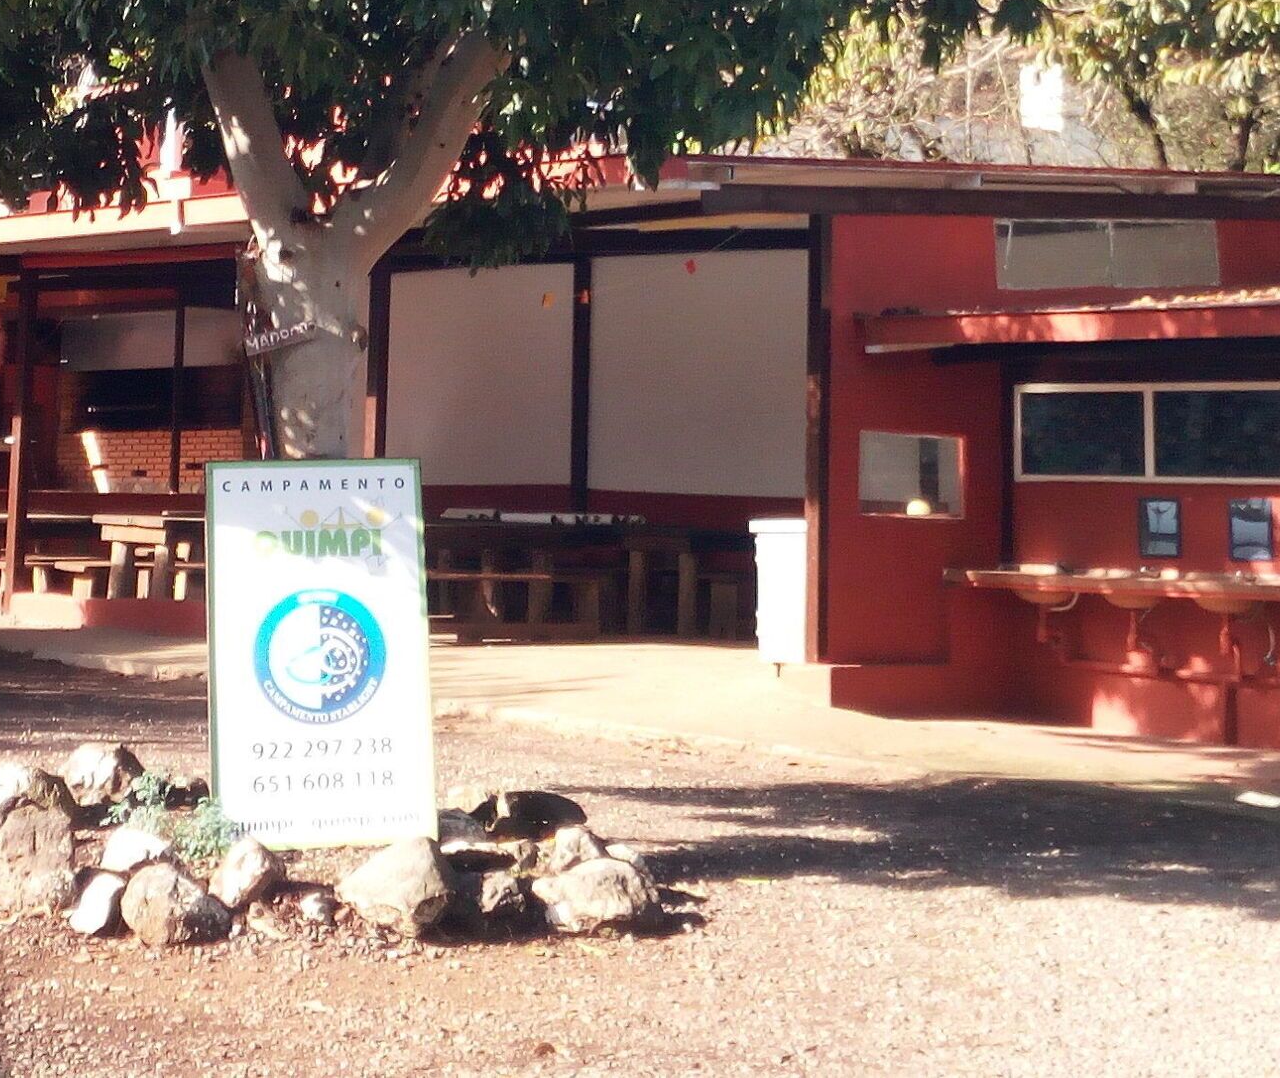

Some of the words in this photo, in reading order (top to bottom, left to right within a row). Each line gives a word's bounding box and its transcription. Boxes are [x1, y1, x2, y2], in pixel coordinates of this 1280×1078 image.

[221, 477, 406, 493] CAMPAMENTO
[254, 527, 382, 558] QUIMPI
[252, 741, 293, 760] 922
[303, 739, 343, 758] 297
[352, 737, 393, 755] 238
[253, 774, 292, 794] 651
[303, 772, 345, 791] 608
[354, 770, 394, 787] 118
